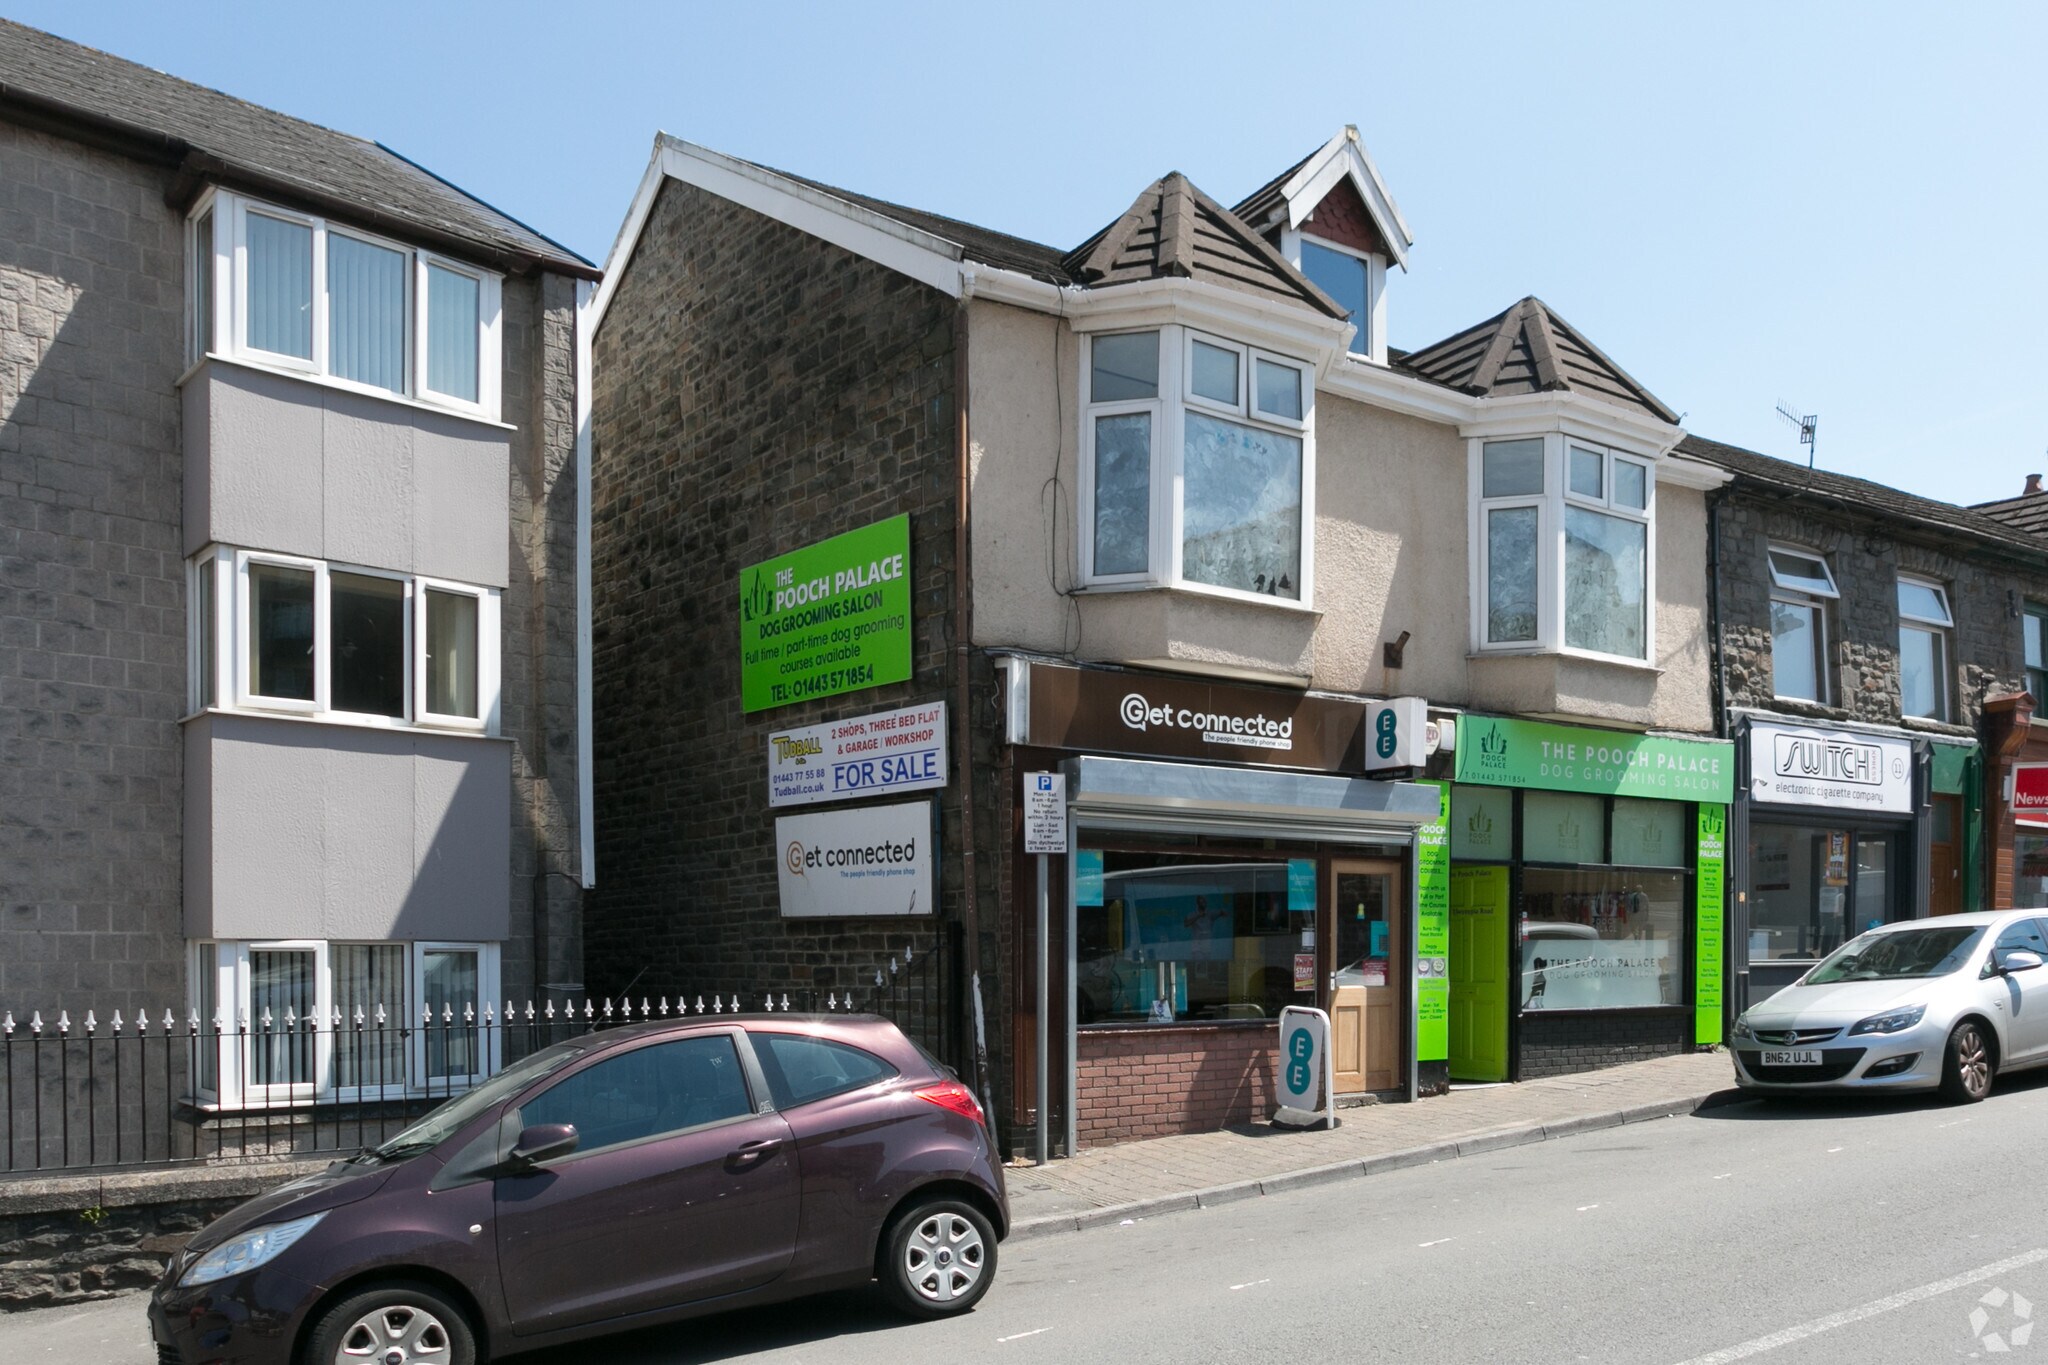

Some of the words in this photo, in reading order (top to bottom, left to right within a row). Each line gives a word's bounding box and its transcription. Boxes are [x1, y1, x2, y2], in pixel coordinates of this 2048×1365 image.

[776, 568, 793, 587] THE
[776, 576, 830, 612] POOCH
[835, 554, 902, 594] PALACE
[760, 619, 780, 640] DOG
[782, 602, 840, 632] GROOMING
[842, 590, 882, 616] SALON
[746, 650, 758, 666] Full
[761, 647, 779, 660] time
[786, 633, 828, 658] part-time
[831, 628, 850, 642] dog
[854, 614, 904, 640] grooming
[780, 657, 813, 674] courses
[816, 645, 860, 666] available
[831, 664, 873, 690] 571854
[832, 728, 836, 739] 2
[838, 724, 868, 738] SHOPS,
[869, 718, 896, 732] THREE
[899, 715, 916, 728] BED
[918, 710, 940, 724] FLAT
[1120, 693, 1174, 732] Get
[1177, 709, 1292, 738] connected
[838, 744, 844, 755] &
[846, 738, 878, 754] GARAGE
[885, 729, 934, 747] WORKSHOP
[1216, 735, 1236, 743] people
[1237, 737, 1258, 746] friendly
[1259, 738, 1276, 747] phone
[834, 762, 875, 789] FOR
[881, 752, 936, 782] SALE
[1481, 754, 1506, 762] POOCH
[1481, 761, 1506, 769] PALACE
[1542, 742, 1576, 760] THE
[1586, 746, 1649, 767] POOCH
[1658, 754, 1719, 774] PALACE
[773, 772, 794, 784] 01443
[795, 770, 803, 781] 77
[806, 770, 814, 779] 55
[816, 768, 825, 778] 88
[1472, 772, 1496, 781] 01443
[1498, 774, 1526, 783] 571854
[1540, 763, 1573, 778] DOG
[1584, 767, 1666, 786] GROOMING
[1675, 776, 1719, 791] SALON
[774, 782, 824, 797] Tudball.co.uk
[1776, 782, 1815, 796] electronic
[1816, 786, 1851, 799] cigarette
[1852, 791, 1883, 804] company
[787, 841, 822, 876] Get
[826, 837, 915, 867] connected
[850, 870, 865, 879] people
[866, 869, 886, 878] friendly
[886, 868, 902, 877] phone
[903, 868, 915, 876] shop
[1550, 959, 1570, 968] THE
[1576, 959, 1613, 968] POOCH
[1618, 959, 1655, 968] PALACE
[1765, 1052, 1790, 1063] BN62
[1794, 1052, 1816, 1063] UJL
